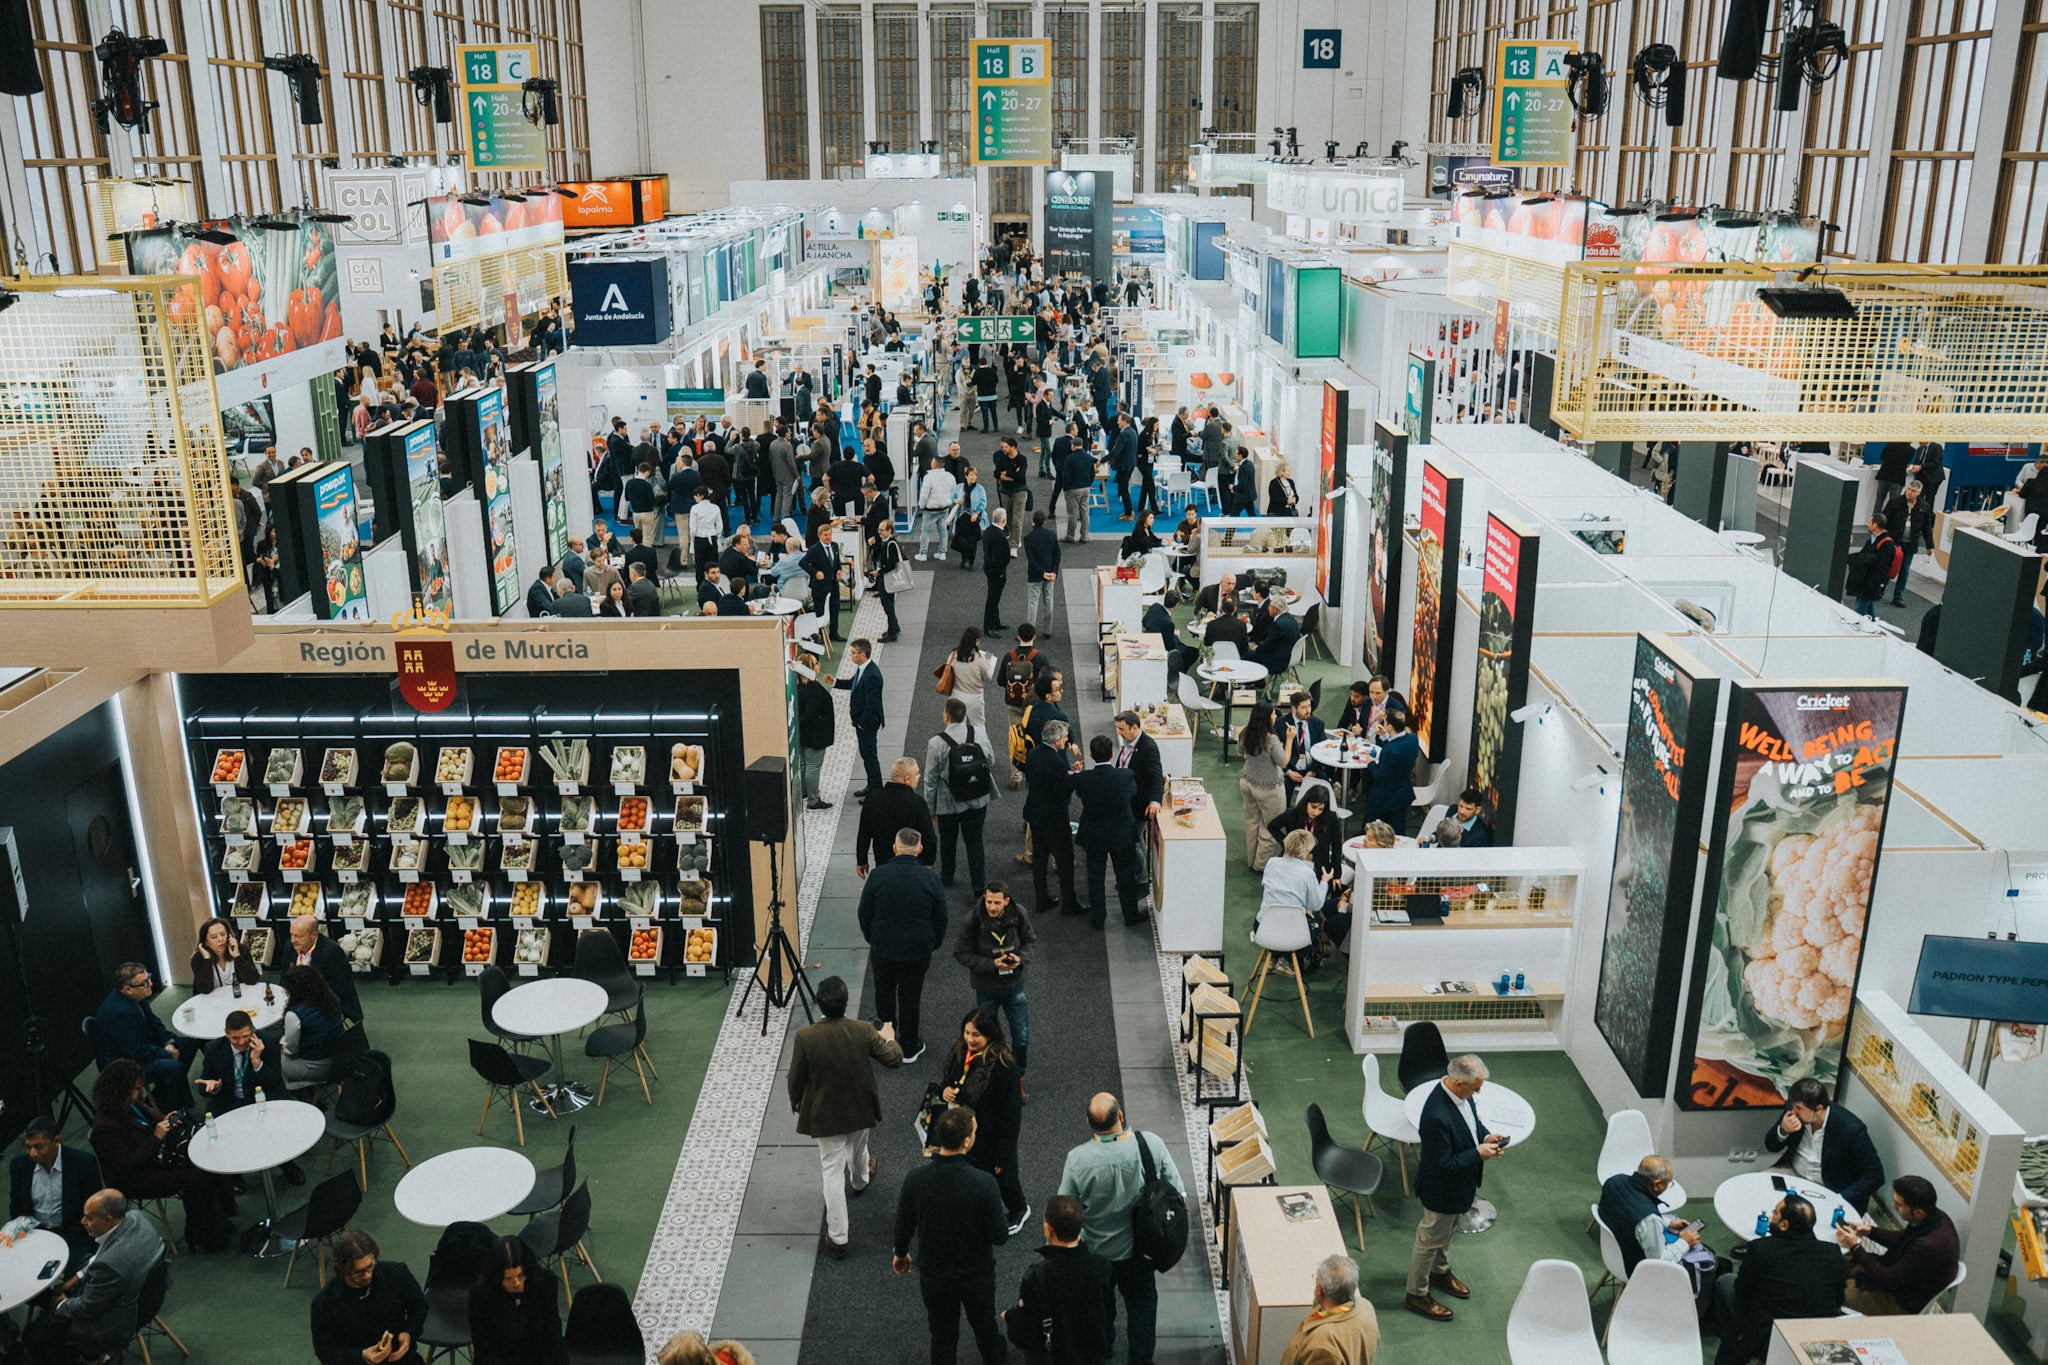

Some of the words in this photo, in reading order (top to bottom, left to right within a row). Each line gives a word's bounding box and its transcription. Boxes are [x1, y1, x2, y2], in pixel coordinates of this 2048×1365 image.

[1310, 38, 1334, 60] 18
[471, 64, 492, 80] 18
[509, 62, 522, 78] C
[983, 58, 1004, 74] 18
[1022, 57, 1034, 74] B
[1510, 60, 1530, 76] 18
[1546, 59, 1561, 76] A
[492, 103, 529, 116] 20-2
[341, 188, 388, 206] CLA
[344, 214, 391, 231] SOL
[352, 264, 376, 274] CLA
[354, 278, 378, 286] SOL
[613, 312, 644, 320] Andalucía
[300, 641, 386, 666] Región
[465, 639, 496, 660] de
[504, 639, 589, 660] Murcia
[1796, 694, 1850, 708] Cricket
[1759, 760, 1773, 777] A
[1778, 752, 1832, 785] WAY
[1835, 752, 1853, 766] TO
[1852, 738, 1896, 768] ACT
[1789, 785, 1815, 798] AND
[1816, 784, 1833, 796] TO
[1833, 767, 1866, 795] BE
[2026, 872, 2048, 880] PRO
[1932, 970, 1984, 983] PADRON
[1987, 975, 2020, 986] TYPE
